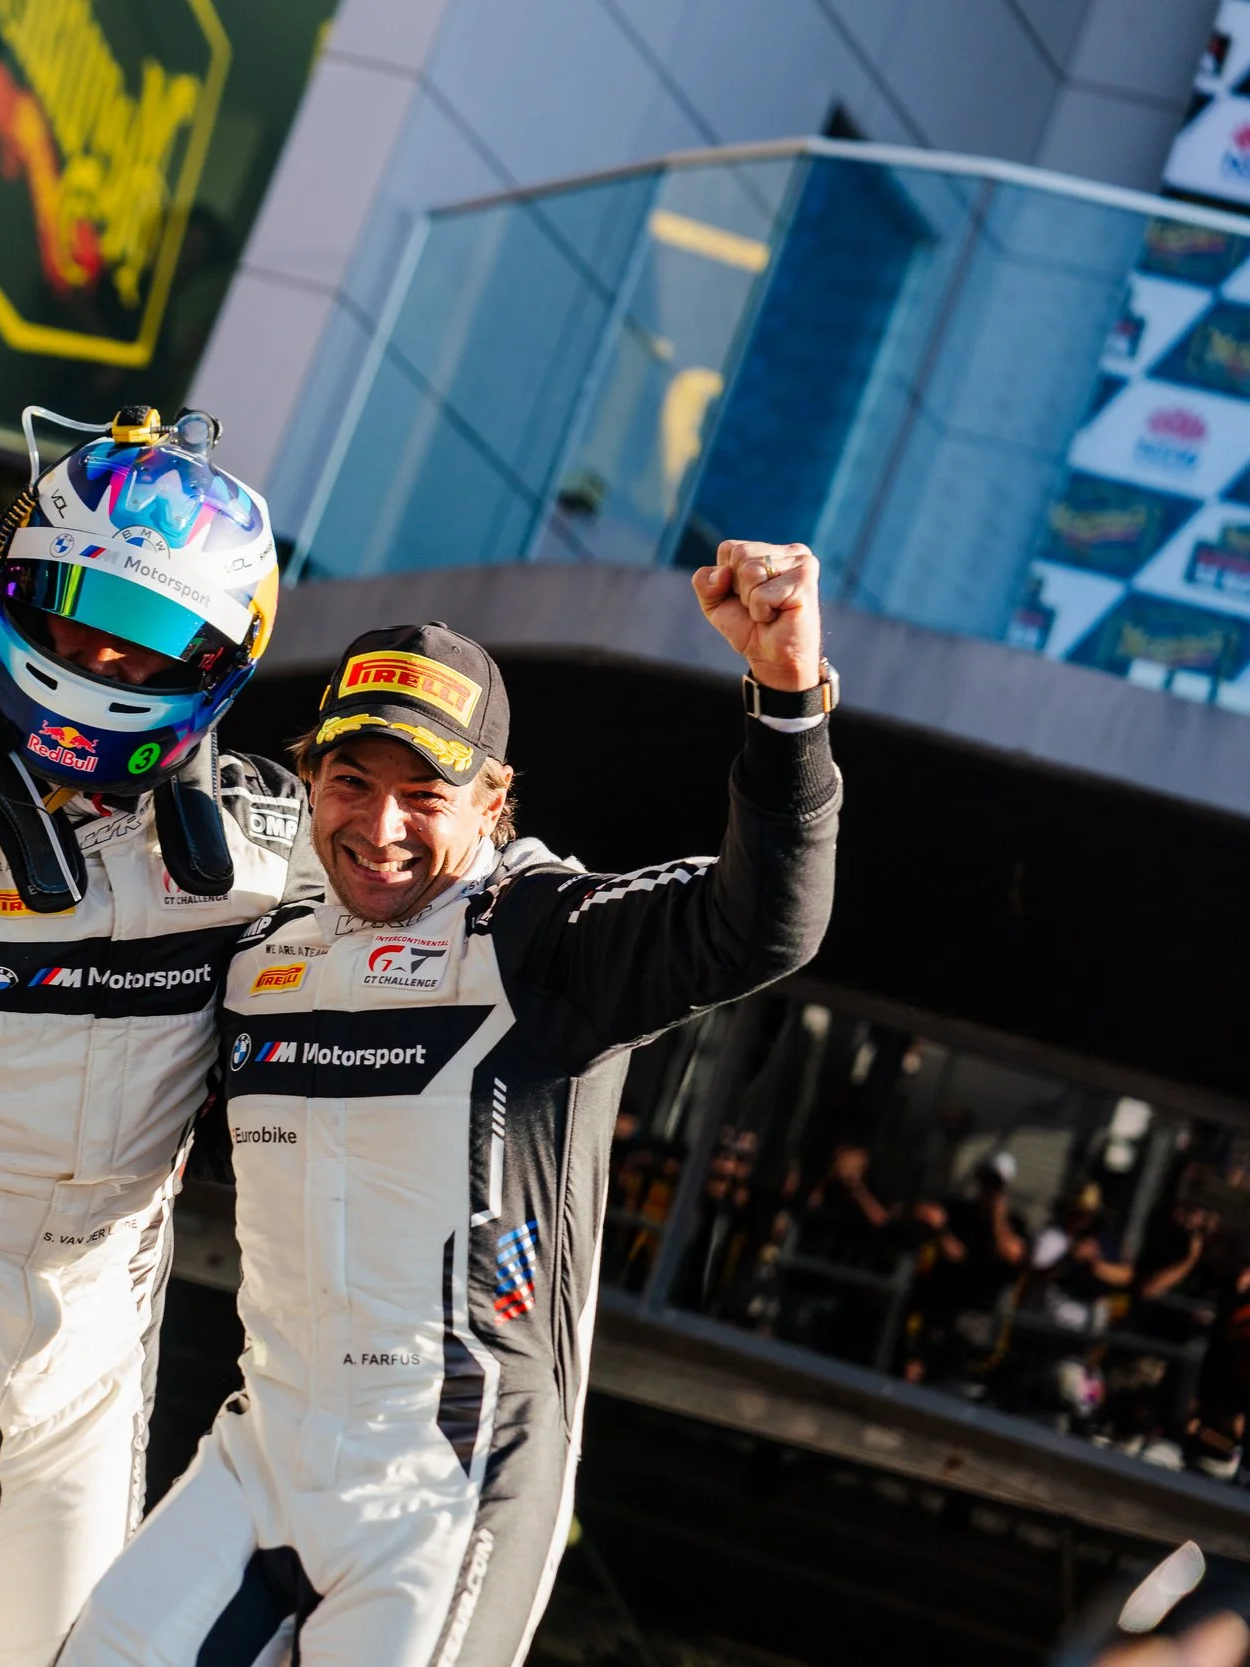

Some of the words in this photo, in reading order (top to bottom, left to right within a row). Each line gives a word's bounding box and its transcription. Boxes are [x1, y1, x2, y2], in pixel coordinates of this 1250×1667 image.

[121, 528, 167, 552] BMW
[123, 555, 211, 609] Motorsport
[346, 658, 471, 712] PIRELLI
[27, 733, 62, 762] Red
[60, 753, 99, 773] Bull
[134, 747, 154, 770] 3
[249, 813, 298, 841] OMP
[164, 896, 175, 905] GT
[177, 894, 229, 905] CHALLENGE
[265, 944, 277, 954] WE
[278, 945, 296, 956] ARE
[297, 947, 304, 956] A
[375, 935, 449, 947] INTERCONTINENTAL
[88, 963, 212, 990] Motorsport
[255, 967, 303, 988] PIRELLI
[363, 975, 378, 985] GT
[378, 975, 438, 988] CHALLENGE
[302, 1042, 426, 1068] Motorsport
[234, 1126, 298, 1144] Eurobike
[43, 1232, 55, 1243] S.
[59, 1235, 85, 1245] VAN
[343, 1353, 356, 1365] A.
[361, 1353, 421, 1365] FARFUS
